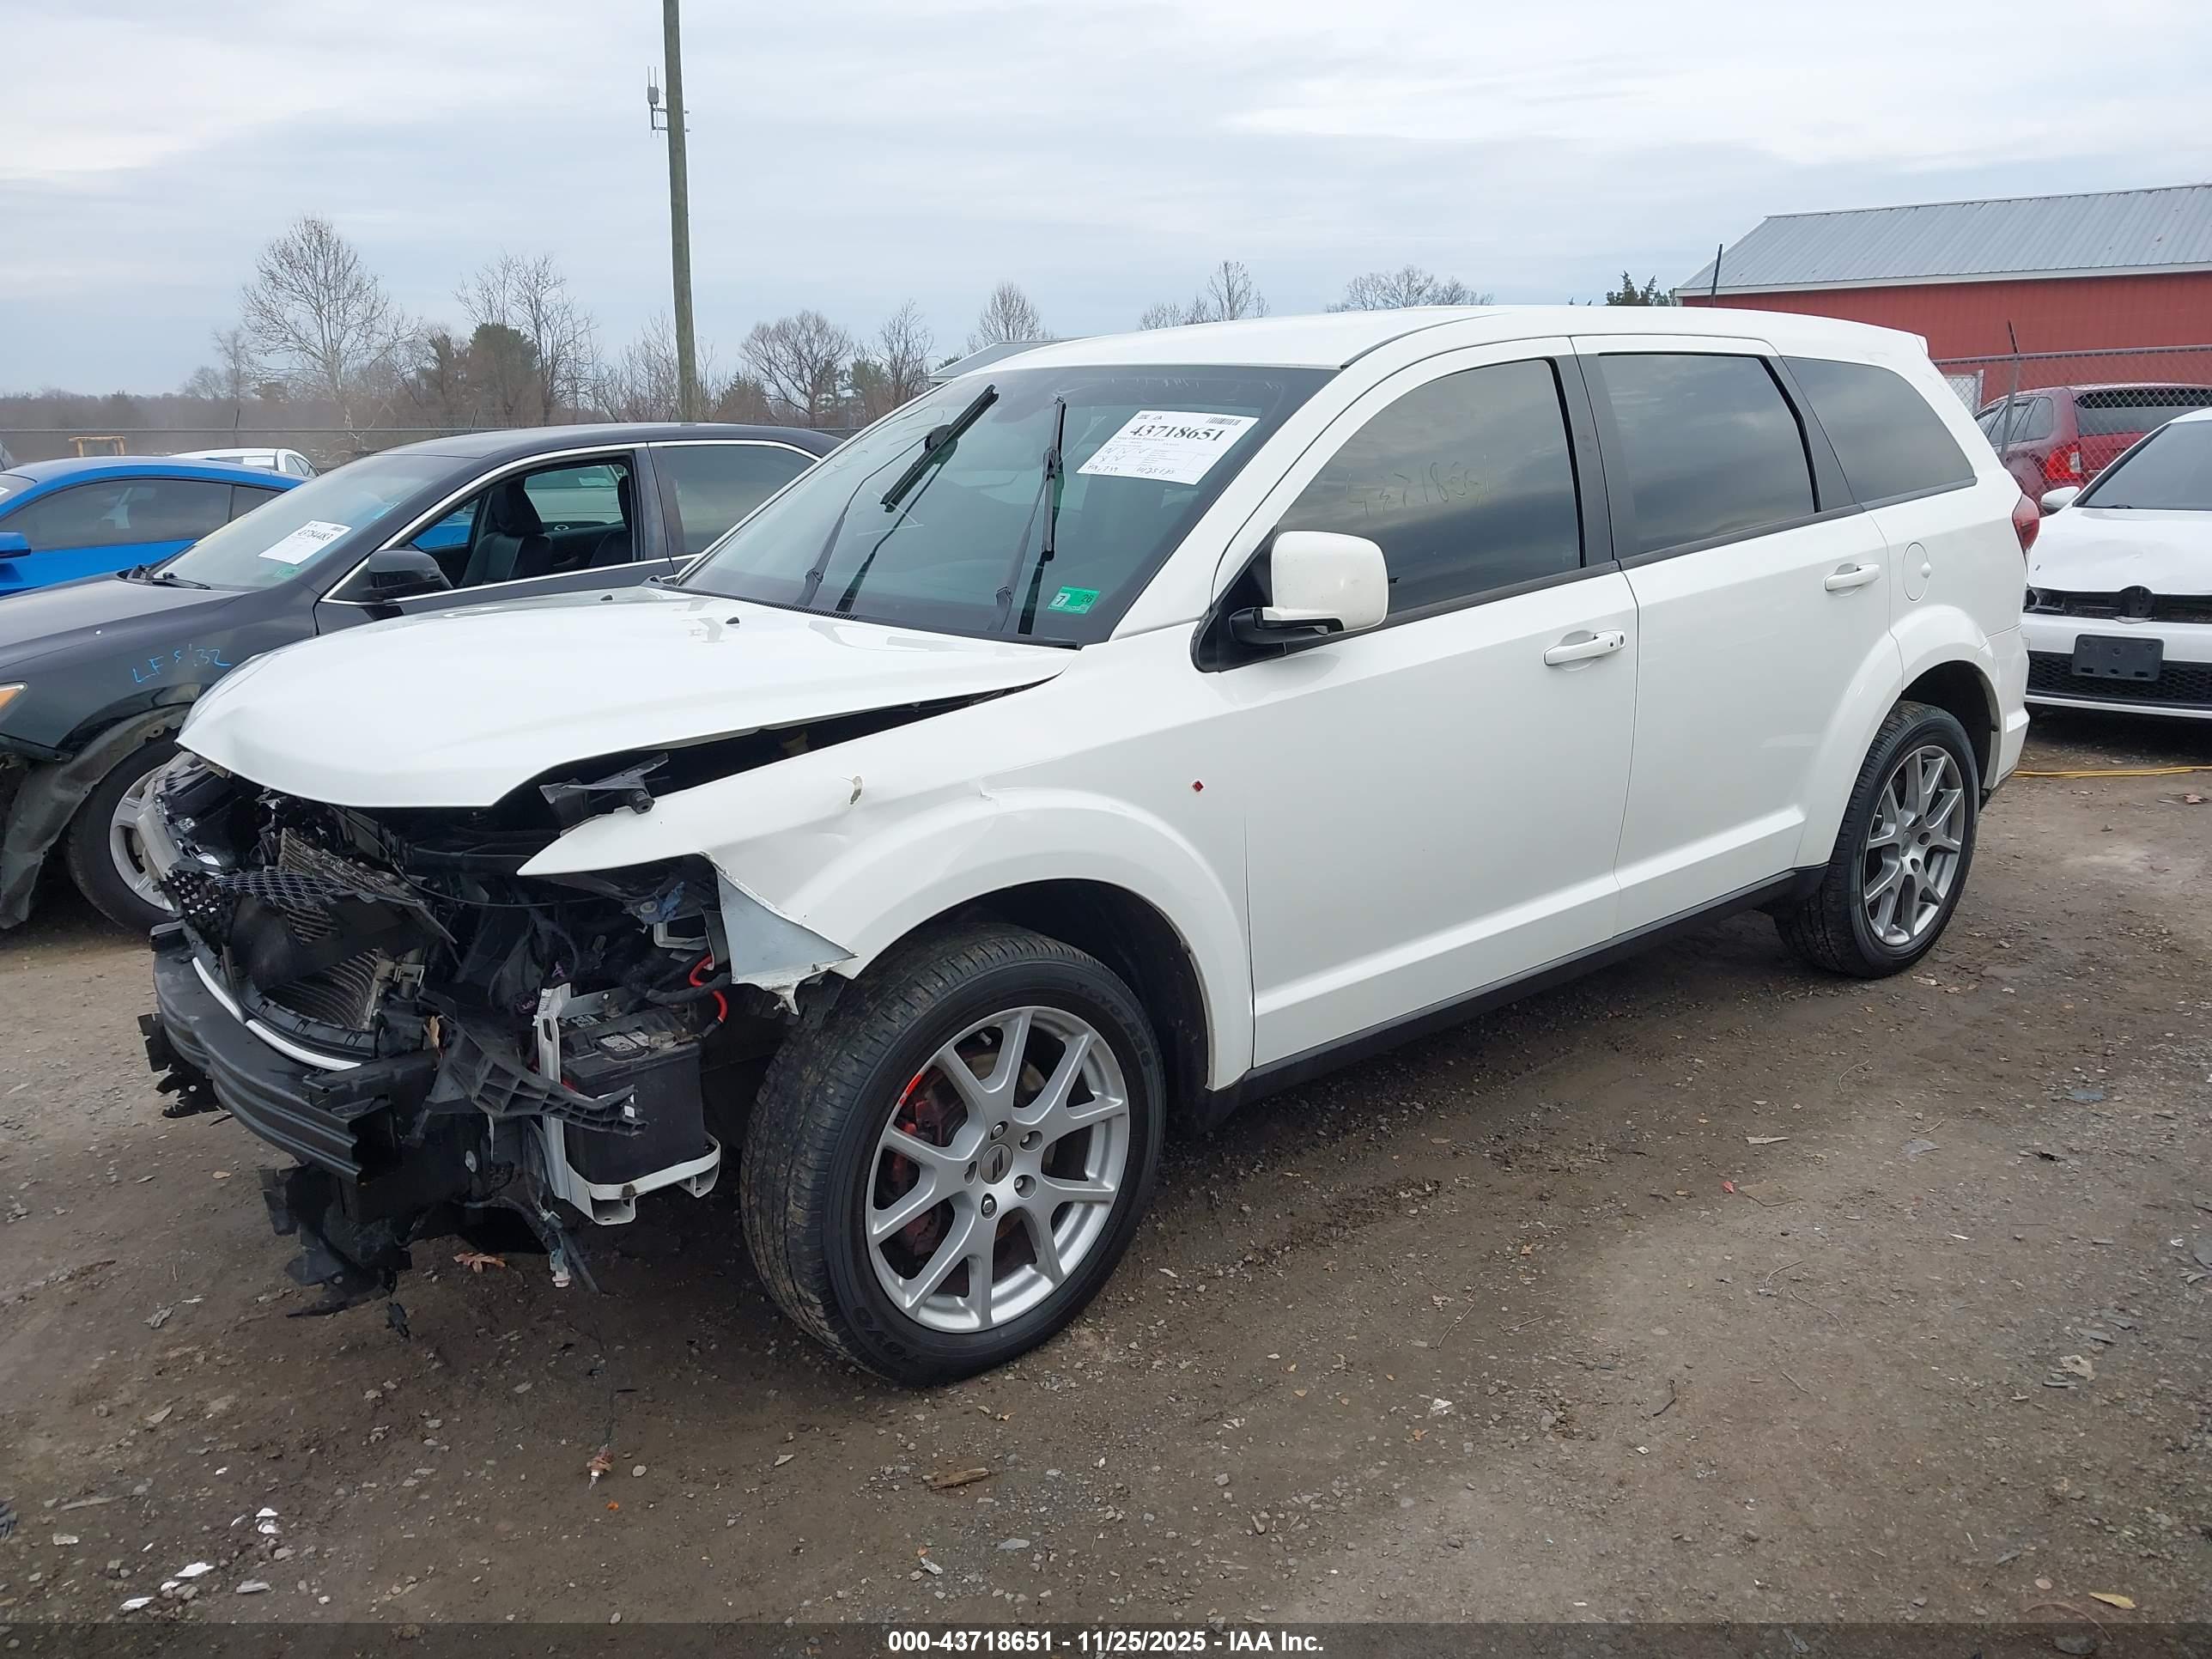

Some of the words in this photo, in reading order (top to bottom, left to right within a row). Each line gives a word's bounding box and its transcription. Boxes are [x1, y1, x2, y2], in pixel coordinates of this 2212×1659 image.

[1129, 424, 1227, 441] 43718651
[1055, 595, 1066, 605] 7
[1081, 593, 1094, 604] 26
